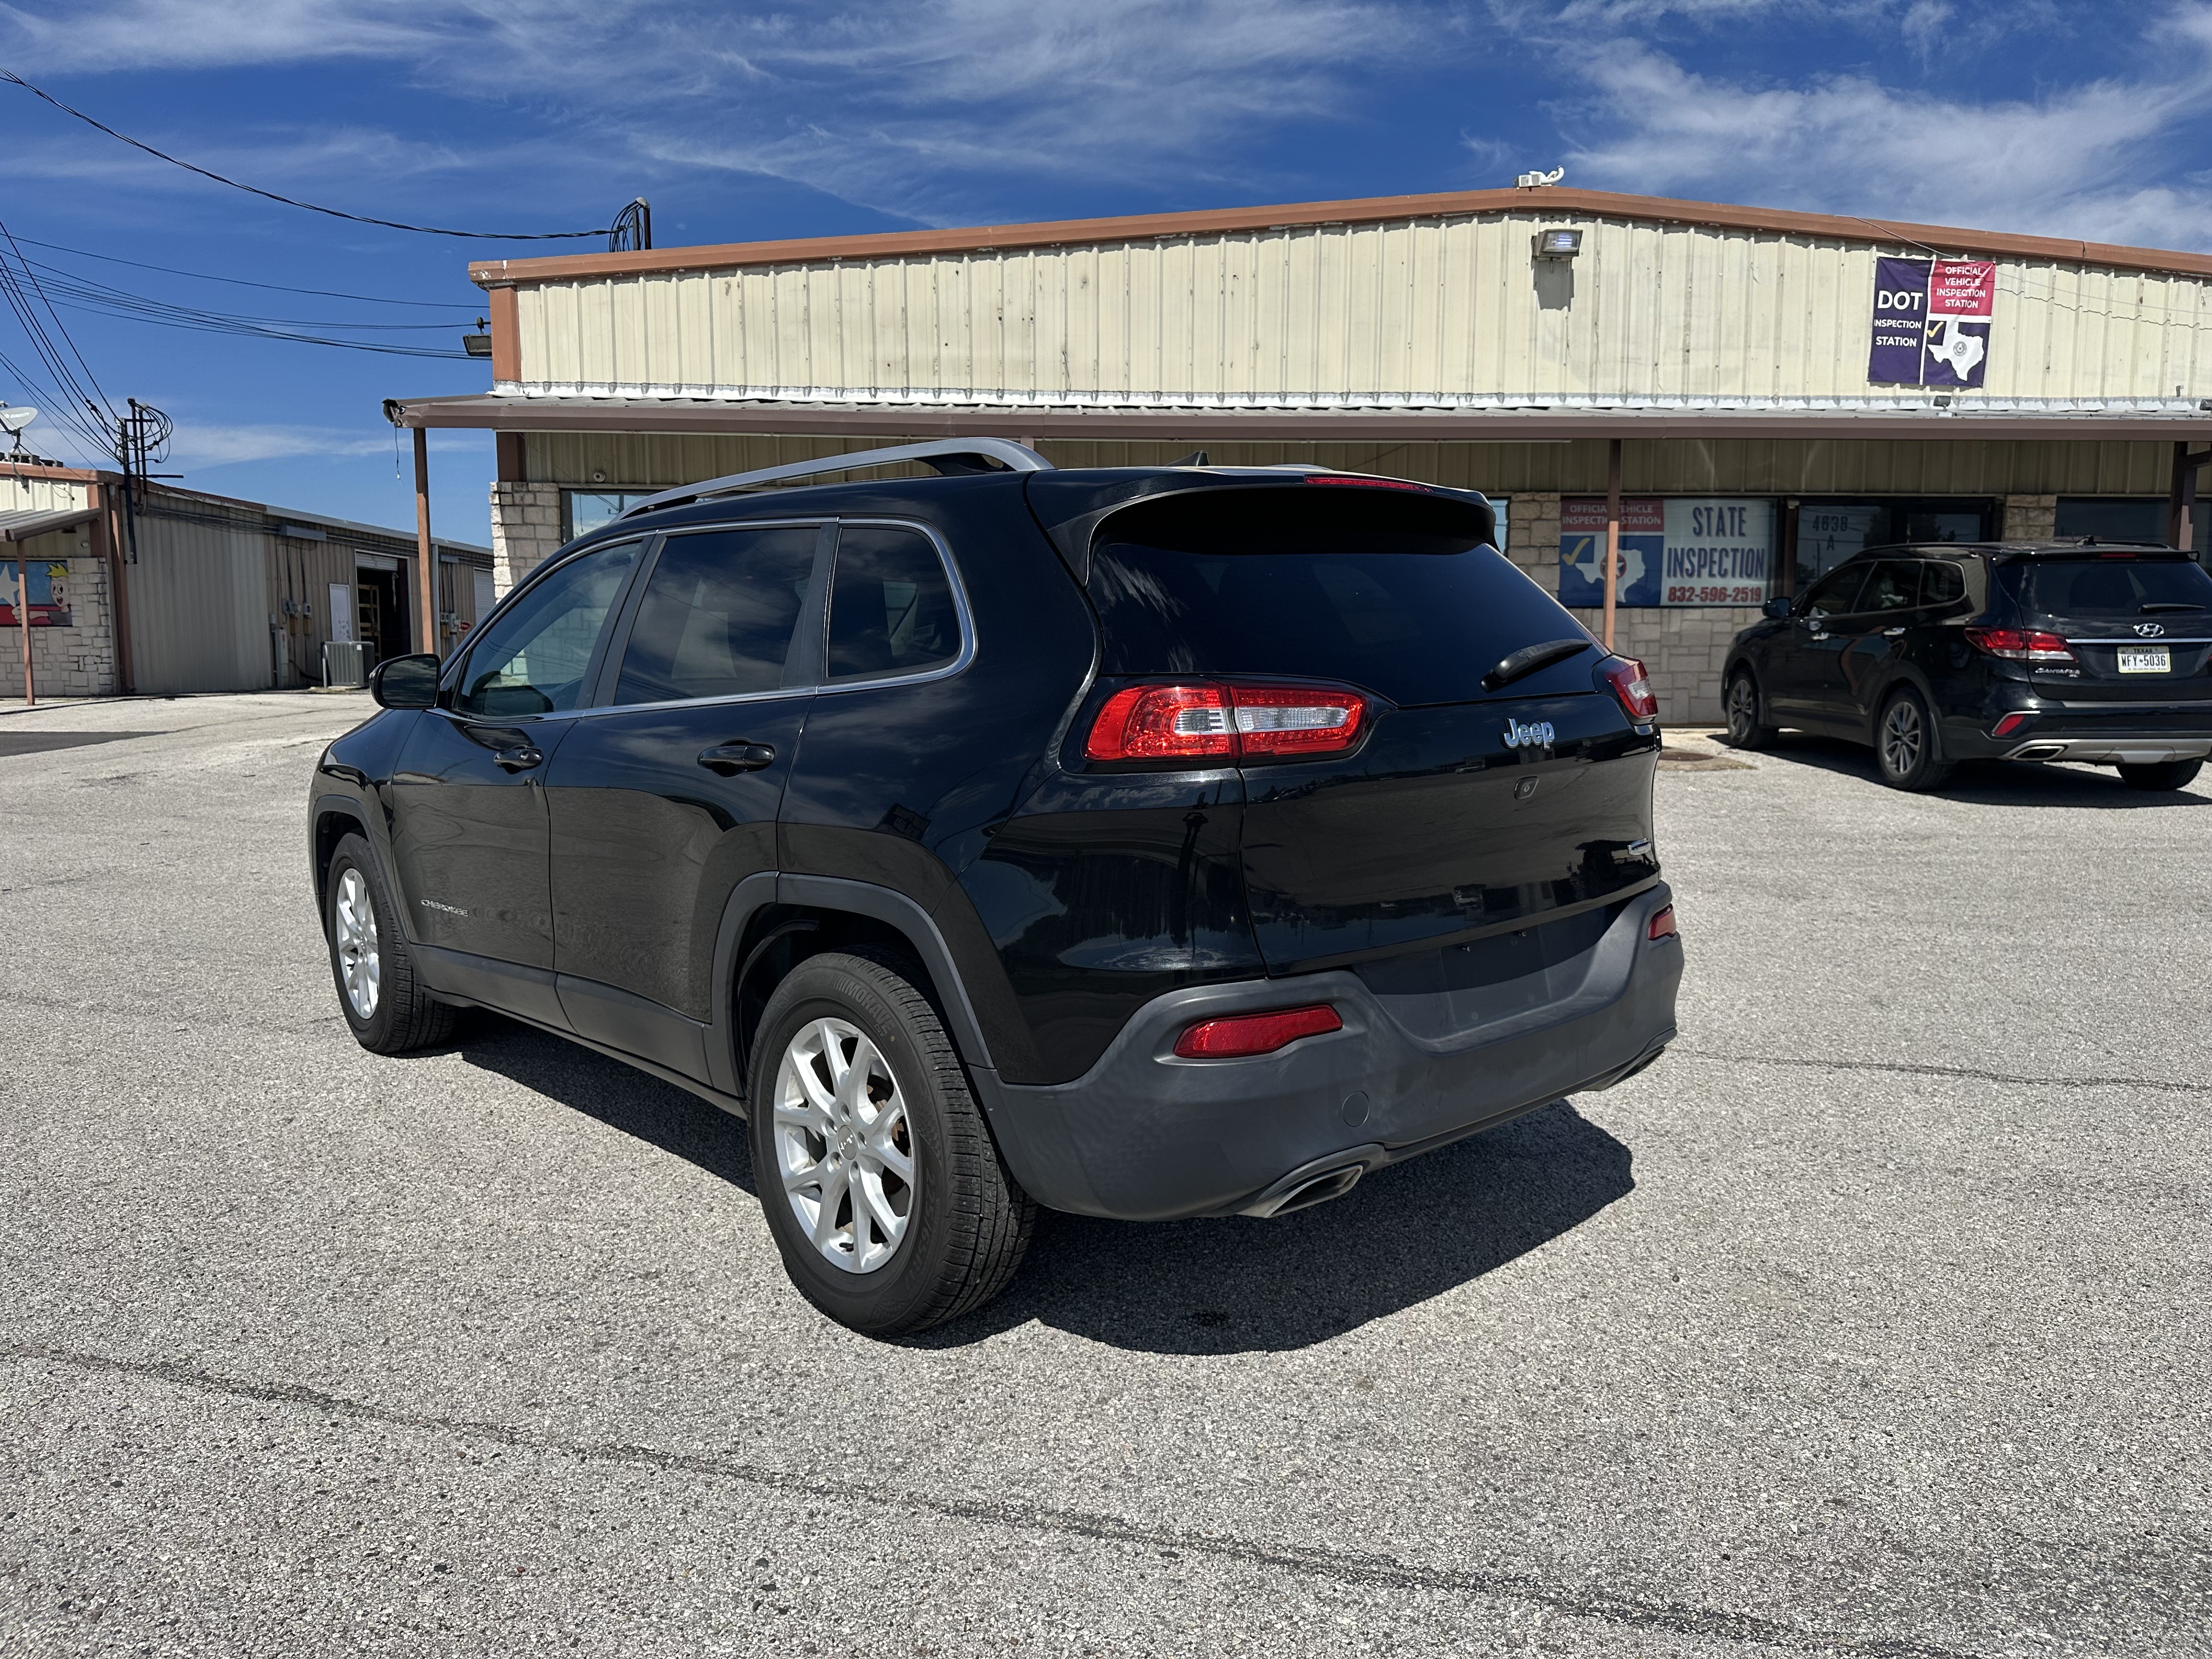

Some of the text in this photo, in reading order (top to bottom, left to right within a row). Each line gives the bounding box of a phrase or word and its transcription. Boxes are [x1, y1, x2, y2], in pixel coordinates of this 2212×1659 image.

[1945, 266, 1982, 275] OFFICIAL
[1945, 278, 1981, 286] VEHICLE
[1877, 290, 1923, 311] DOT
[1936, 288, 1986, 298] INSPECTION
[1945, 299, 1978, 308] STATION
[1874, 319, 1922, 329] INSPECTION
[1875, 336, 1917, 347] STATION
[1570, 505, 1654, 513] OFFICIA EHICLE
[1562, 516, 1661, 524] INSPECTI STATION
[1692, 506, 1747, 537] STATE
[1812, 515, 1848, 532] 4638
[1826, 534, 1835, 550] A
[1666, 548, 1765, 579] INSPECTION
[1667, 586, 1762, 602] 832-596-2519
[1503, 718, 1555, 750] Jeep
[420, 899, 469, 917] CHEROKEE
[847, 979, 896, 1035] MOHAVE
[874, 1023, 886, 1037] CUV
